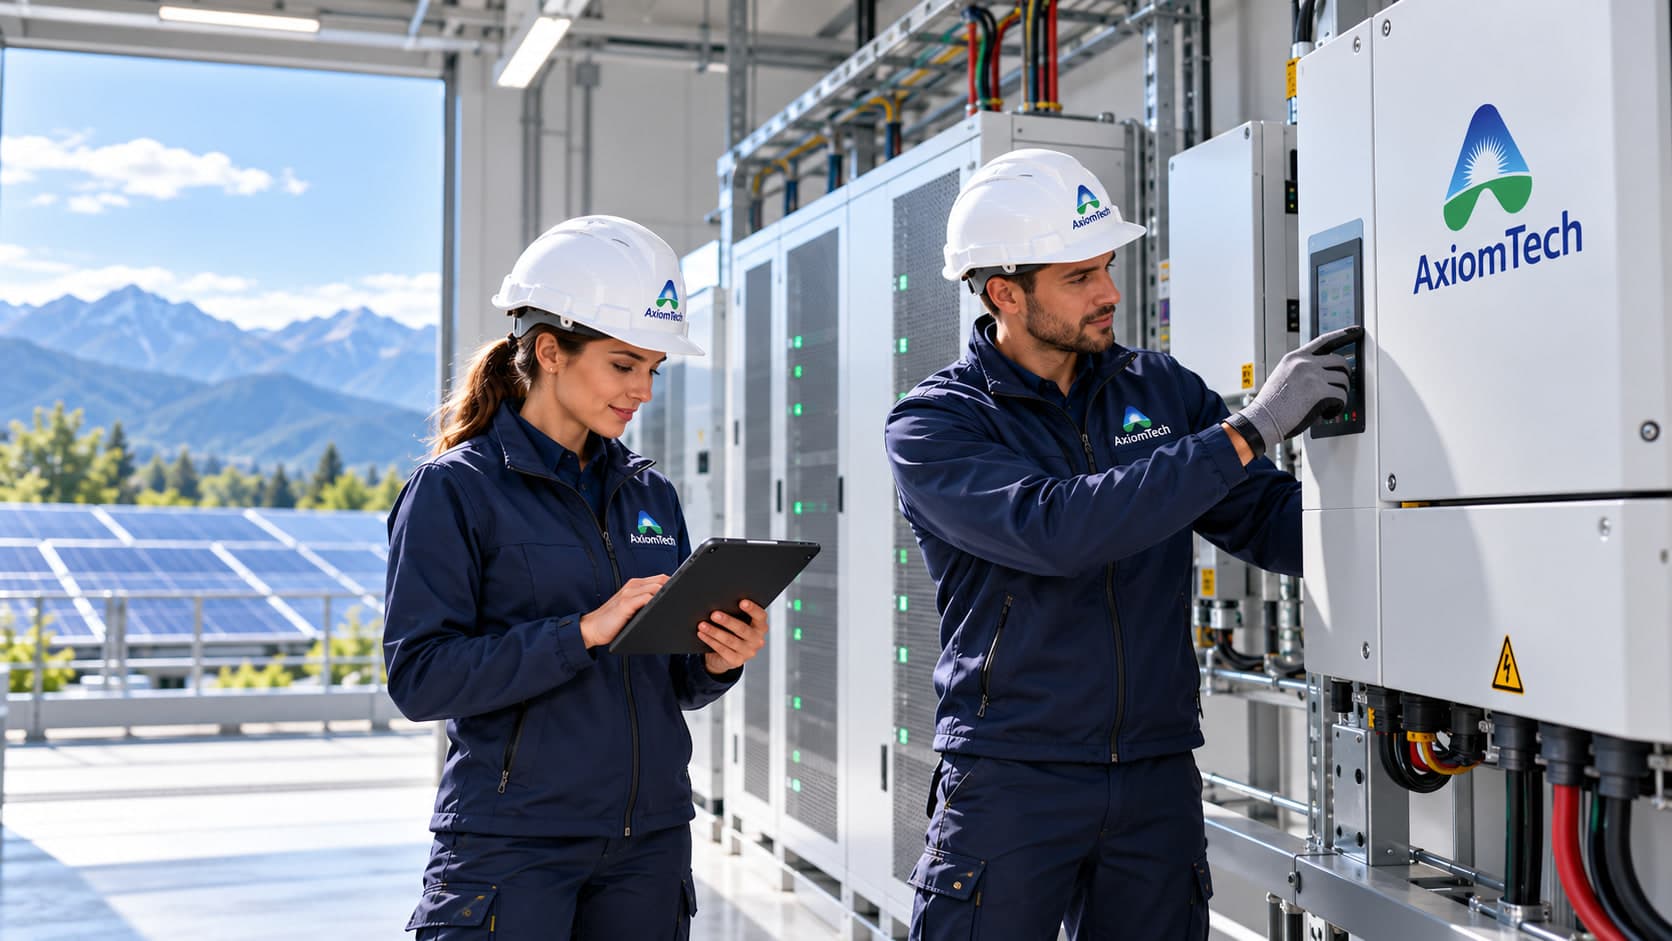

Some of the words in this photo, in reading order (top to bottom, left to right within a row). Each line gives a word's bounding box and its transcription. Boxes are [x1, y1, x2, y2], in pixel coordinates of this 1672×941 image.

[1413, 210, 1583, 295] AxiomTech
[1114, 424, 1171, 447] AxiomTech
[630, 533, 676, 546] AxiomTech
